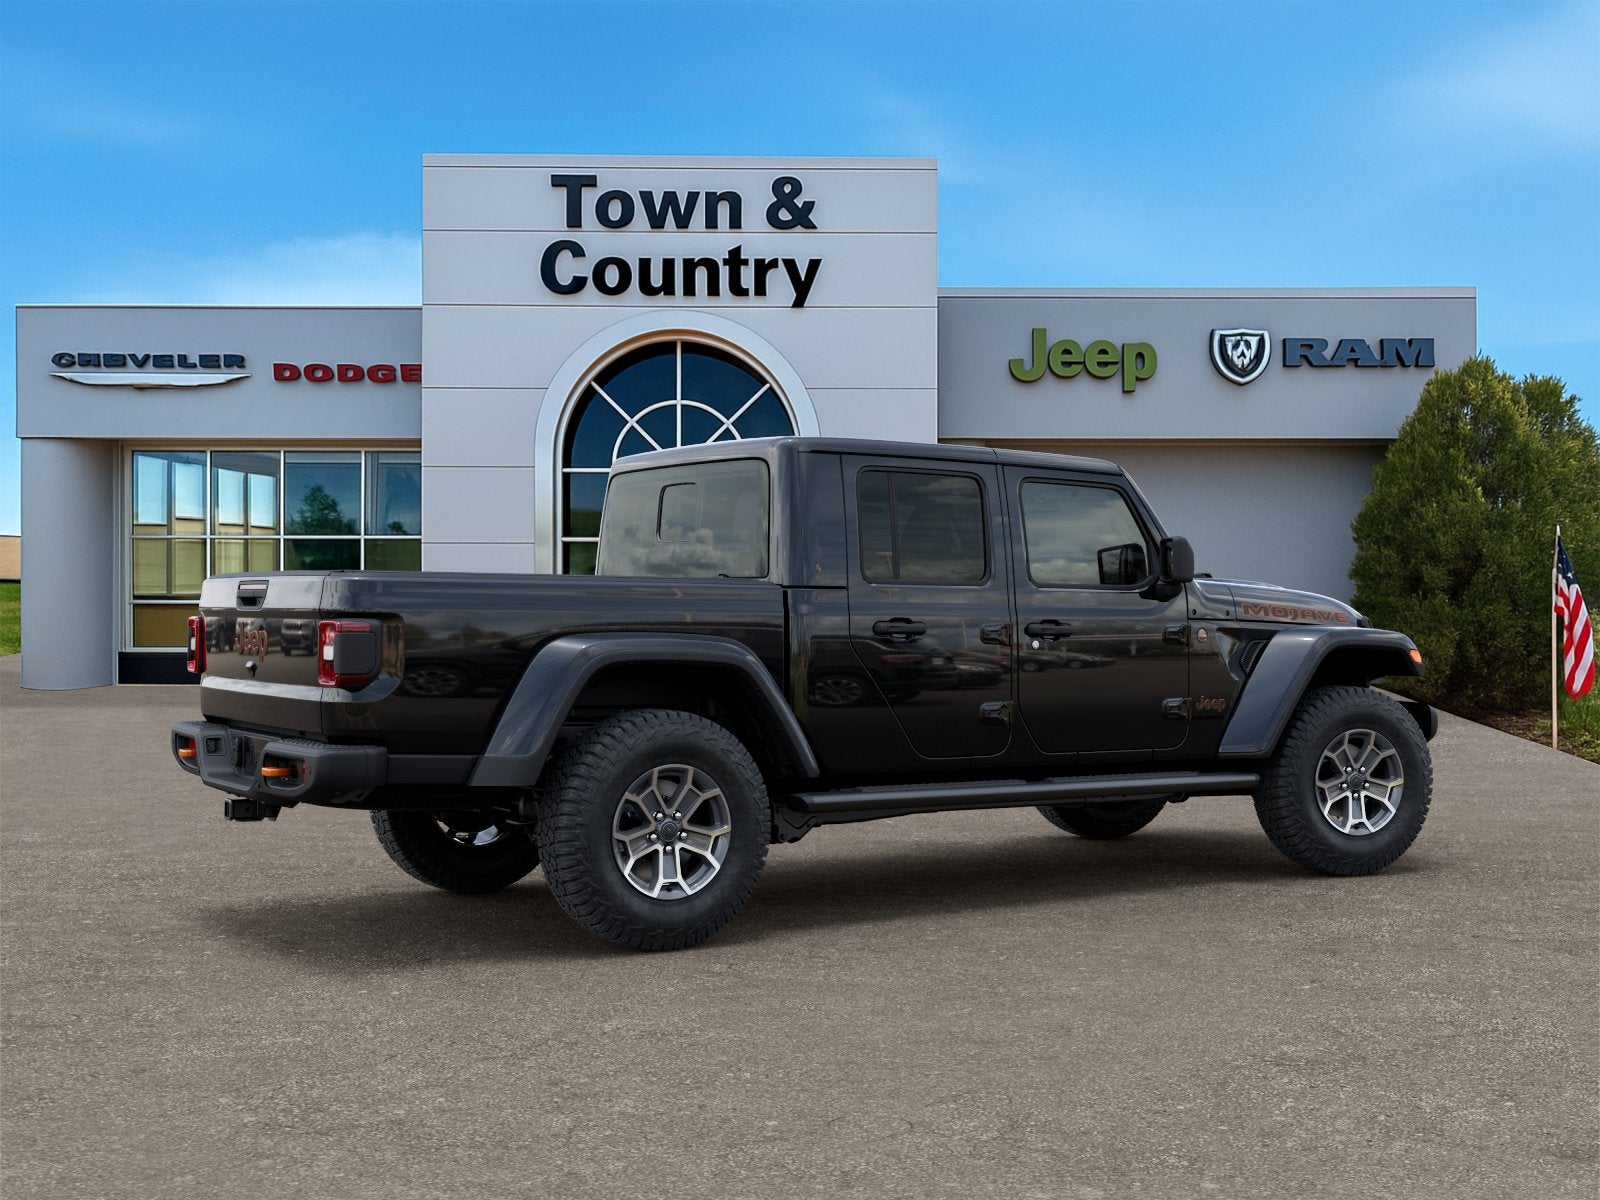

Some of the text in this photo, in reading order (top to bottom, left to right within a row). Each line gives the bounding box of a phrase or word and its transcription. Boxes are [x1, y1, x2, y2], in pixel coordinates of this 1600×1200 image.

[550, 174, 818, 230] Town &
[540, 239, 823, 308] Country
[1008, 327, 1158, 393] Jeep
[1283, 337, 1436, 368] RAM
[273, 362, 422, 383] DODGE
[1241, 603, 1350, 625] MOJAVE
[234, 621, 269, 664] Jeep
[1195, 695, 1226, 713] Jeep
